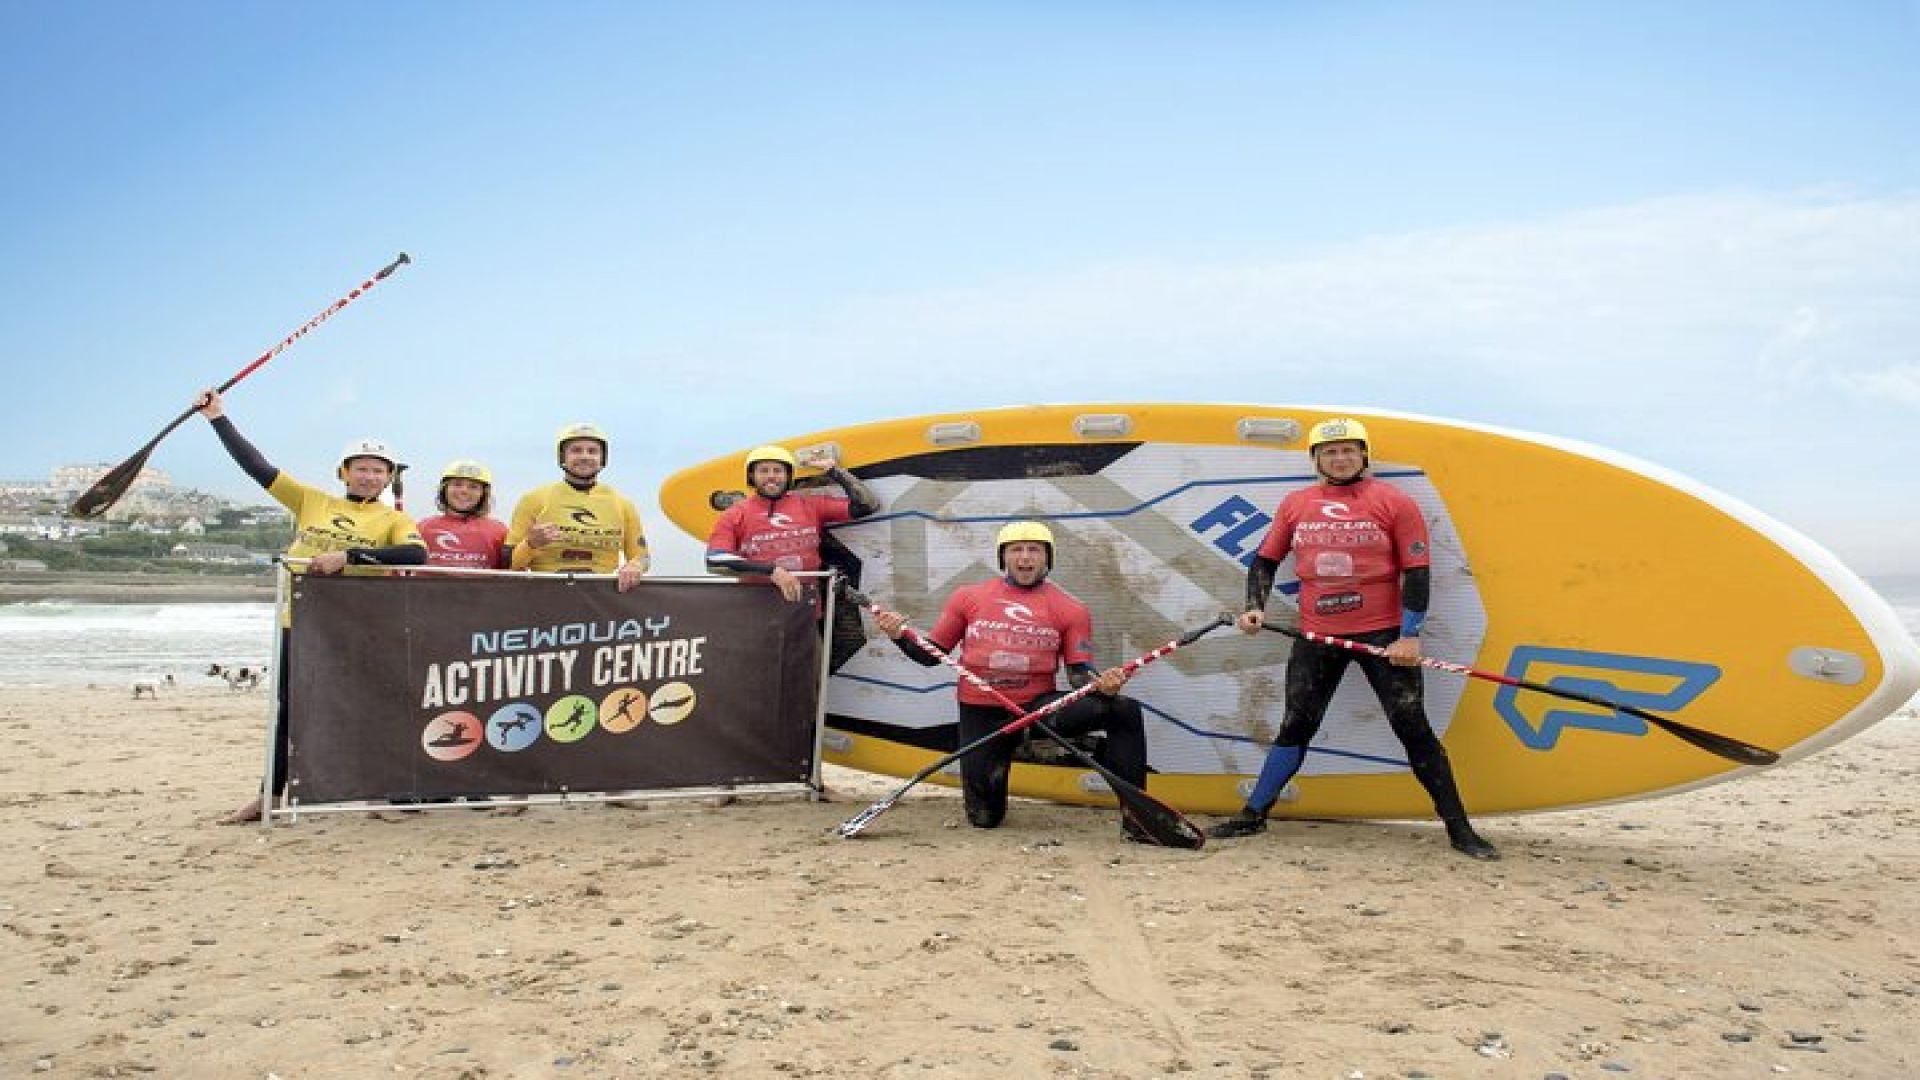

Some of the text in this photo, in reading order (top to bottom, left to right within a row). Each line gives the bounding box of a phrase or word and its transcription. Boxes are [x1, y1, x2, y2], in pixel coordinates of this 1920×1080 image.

[471, 616, 671, 654] NEWQUAY
[421, 636, 707, 709] ACTIVITY CENTRE
